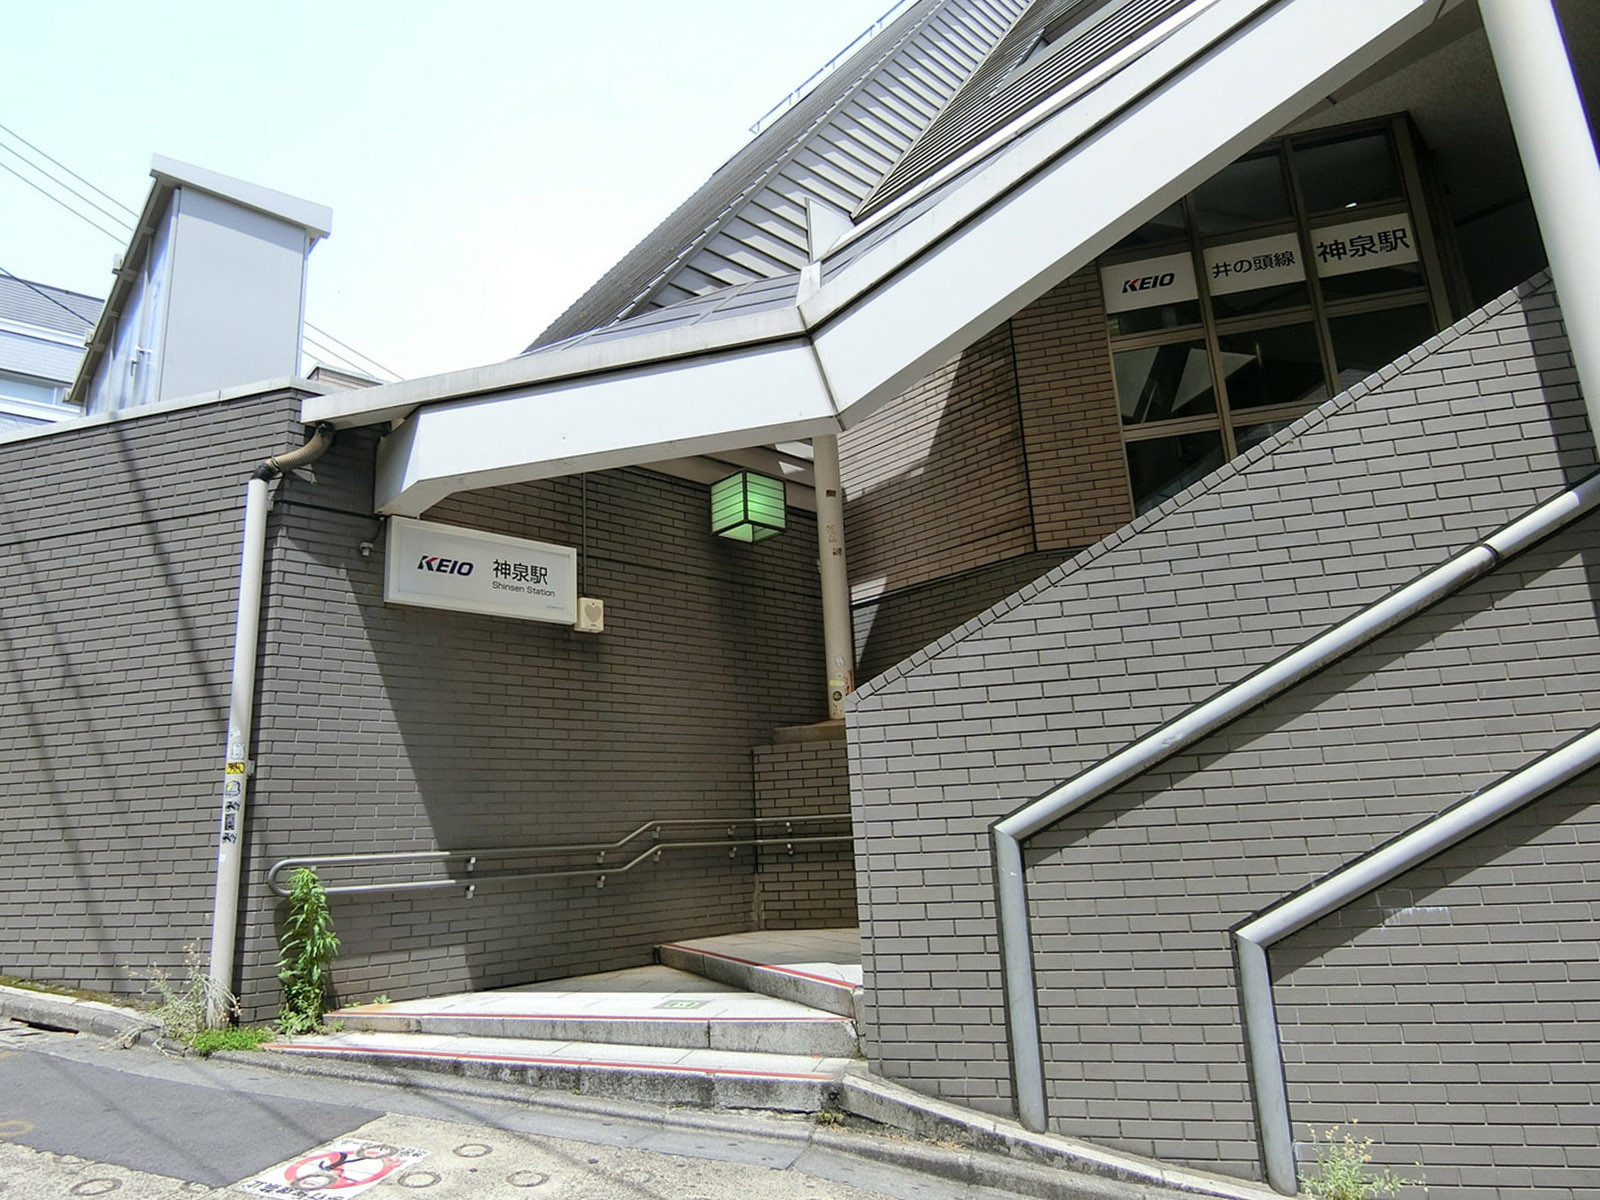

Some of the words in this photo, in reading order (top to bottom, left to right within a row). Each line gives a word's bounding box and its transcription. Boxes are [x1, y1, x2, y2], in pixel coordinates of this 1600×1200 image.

[1317, 228, 1410, 263] 神泉駅
[1212, 251, 1295, 279] 井の頭線
[1122, 272, 1175, 294] KEIO
[417, 555, 474, 577] KEIO
[493, 558, 548, 585] 神泉駅
[492, 581, 525, 593] Shinsen
[527, 583, 556, 597] Station
